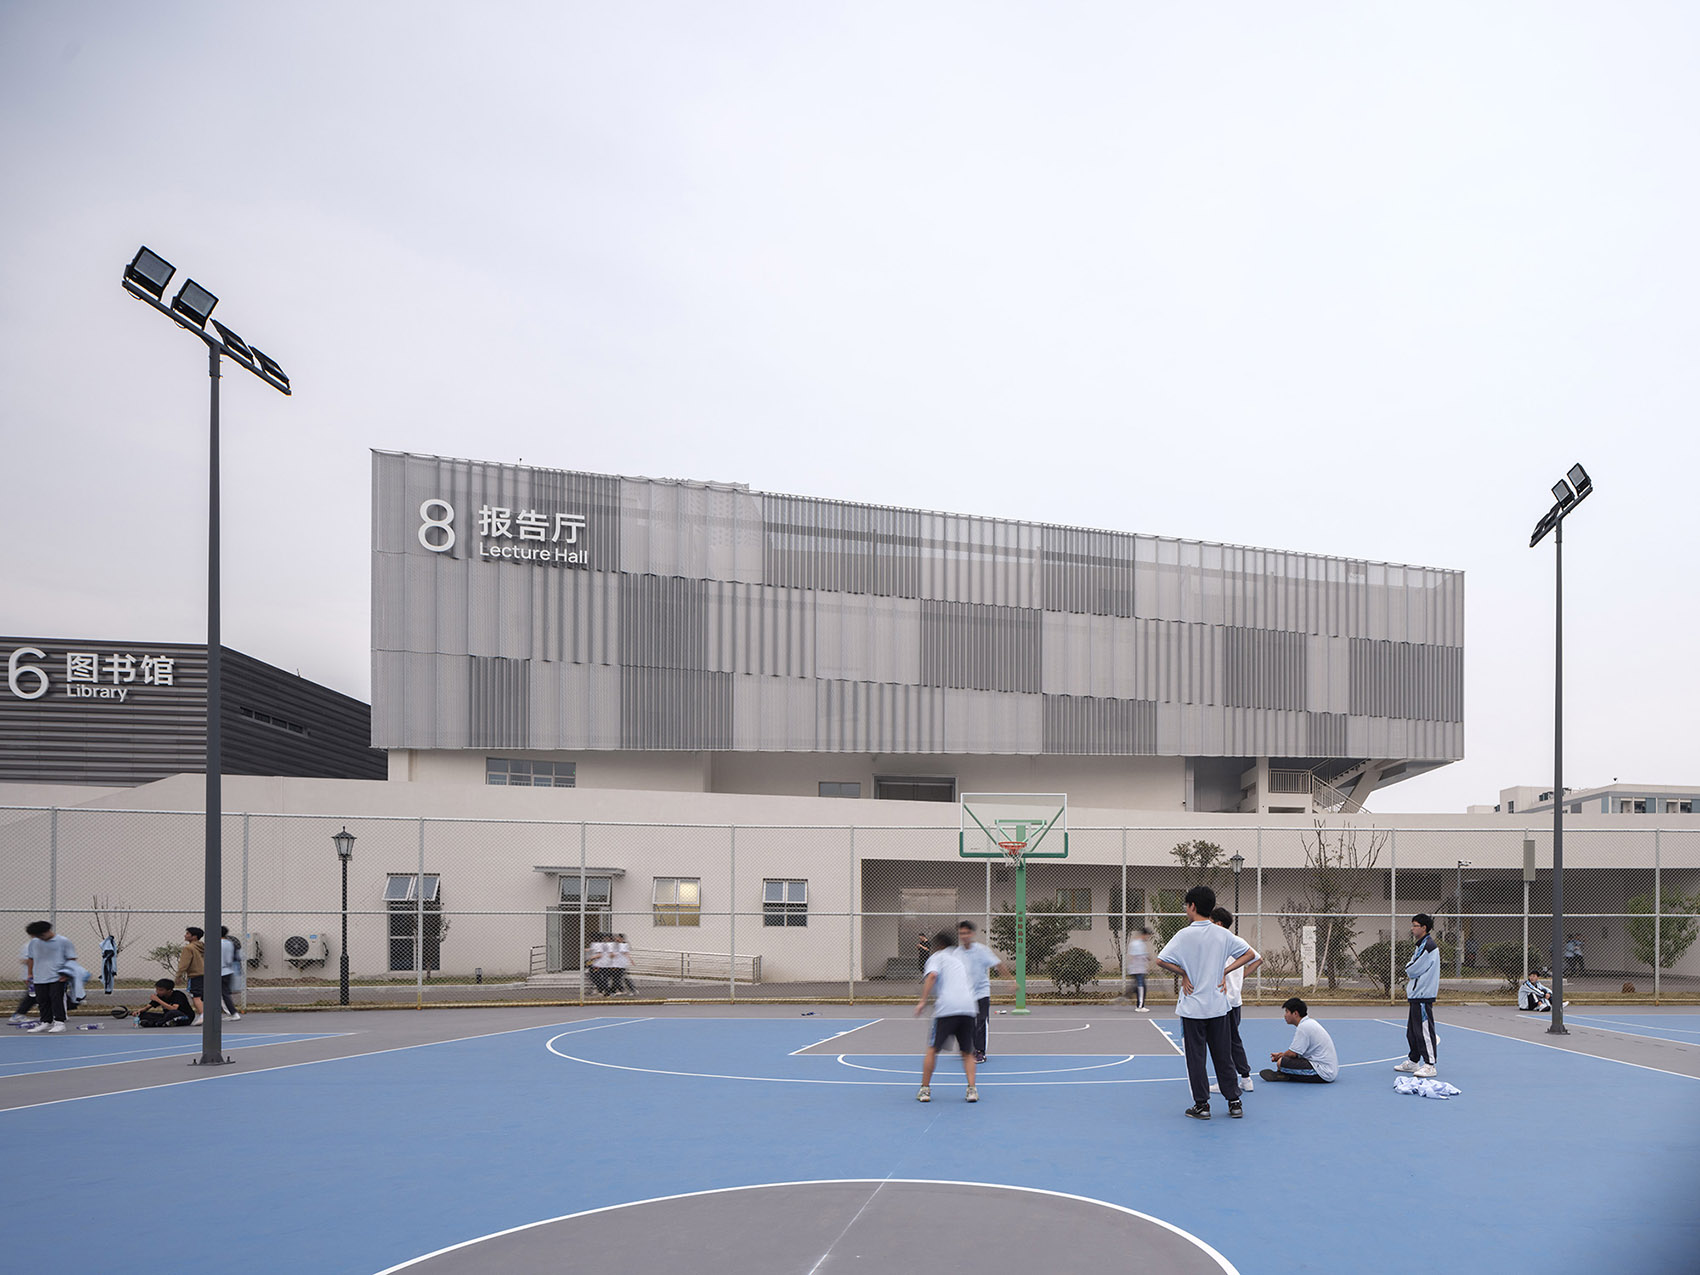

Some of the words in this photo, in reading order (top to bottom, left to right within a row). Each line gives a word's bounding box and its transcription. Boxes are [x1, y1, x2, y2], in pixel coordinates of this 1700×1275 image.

[418, 498, 456, 552] 8
[478, 504, 586, 544] 报告厅
[479, 541, 551, 561] Lecture
[555, 547, 588, 564] Hall
[8, 647, 50, 700] 6
[66, 652, 175, 686] 图书馆
[66, 684, 128, 702] Library
